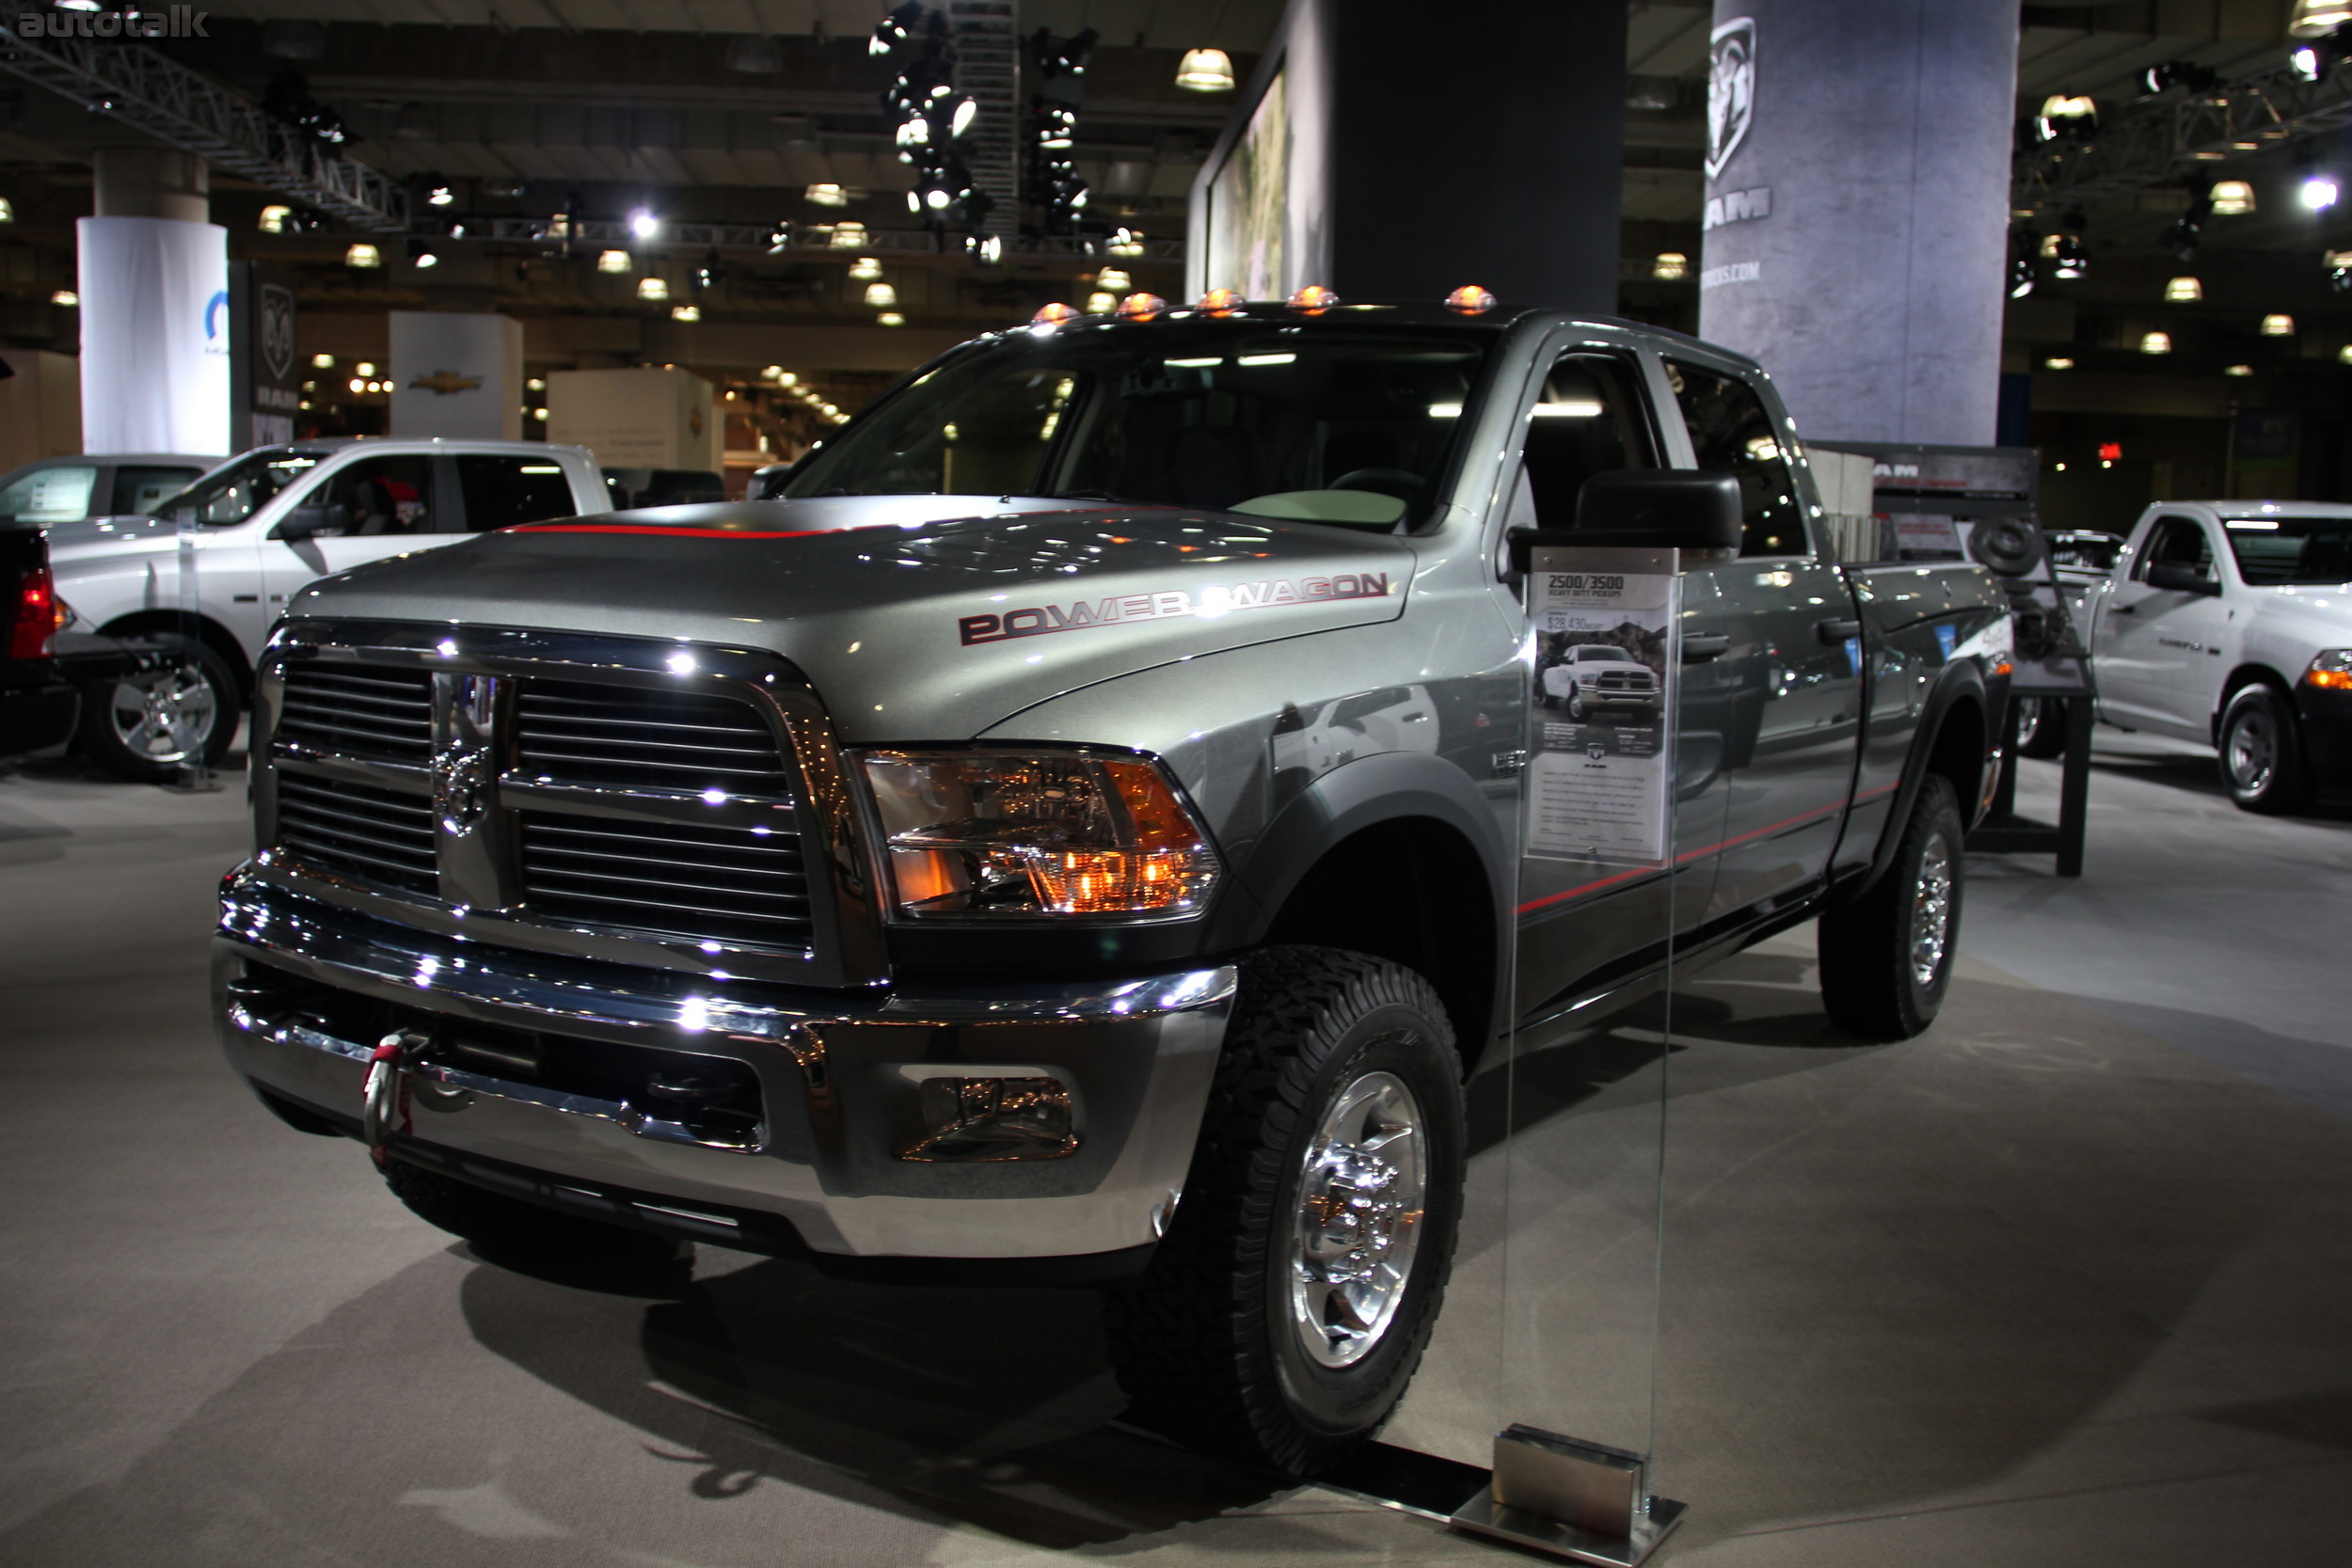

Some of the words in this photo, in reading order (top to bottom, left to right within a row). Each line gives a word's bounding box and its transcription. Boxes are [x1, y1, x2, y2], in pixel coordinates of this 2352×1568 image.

[1703, 187, 1770, 230] AM
[257, 387, 298, 409] RAM
[1873, 465, 1919, 477] AM
[1549, 575, 1624, 590] 2500/3500
[959, 590, 1193, 646] POWER
[1200, 572, 1390, 614] WAGON
